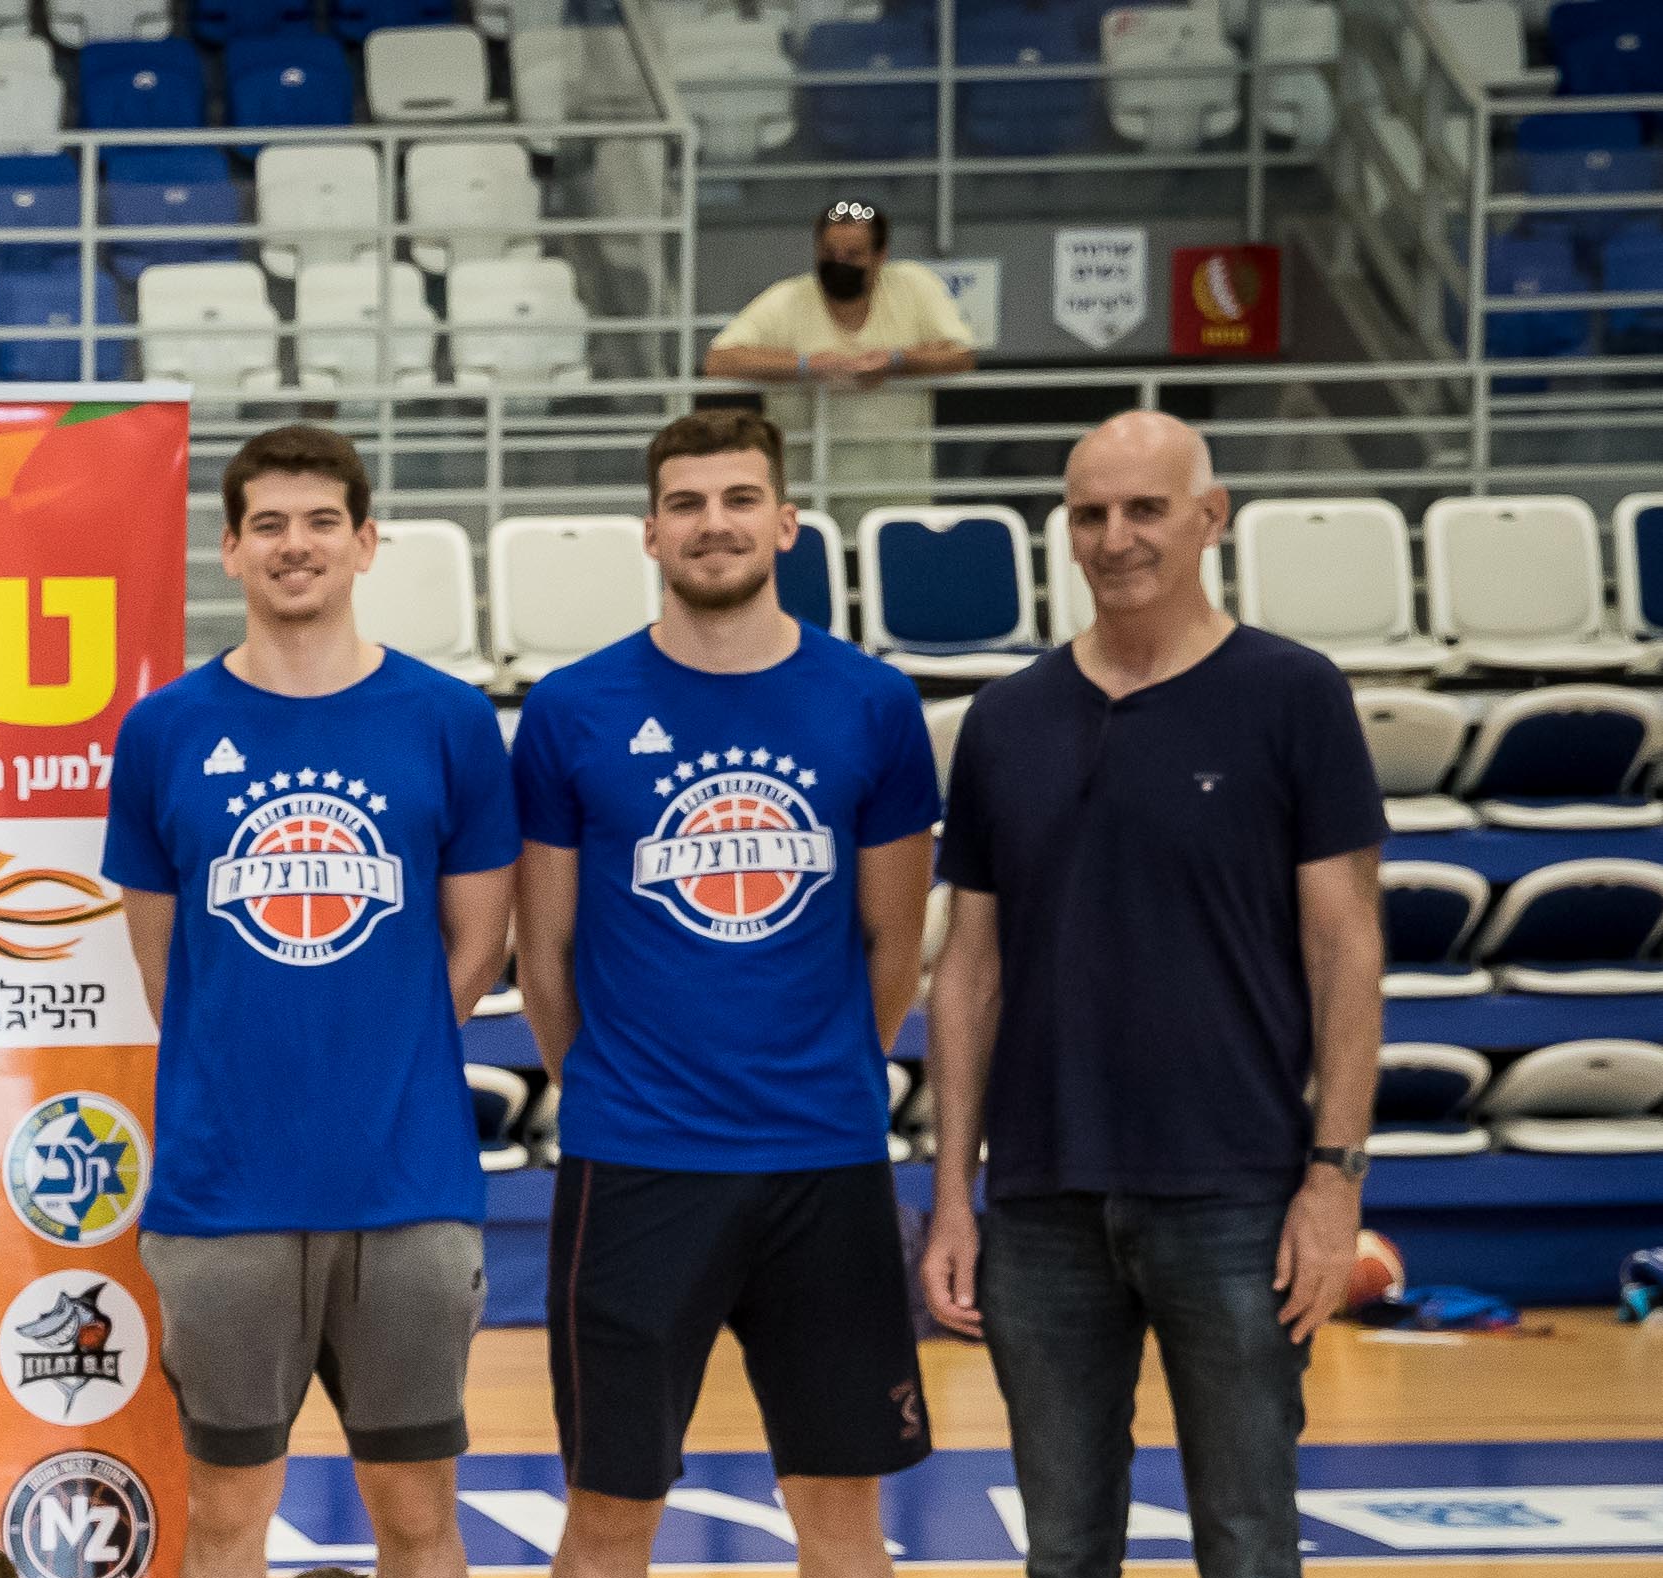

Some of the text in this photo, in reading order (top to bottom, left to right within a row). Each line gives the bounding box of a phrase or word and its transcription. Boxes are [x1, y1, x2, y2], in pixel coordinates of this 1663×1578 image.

[14, 741, 115, 801] למען
[229, 860, 381, 895] בני הרצליה
[656, 837, 816, 875] בני הרצליה
[38, 1494, 121, 1562] NZ
